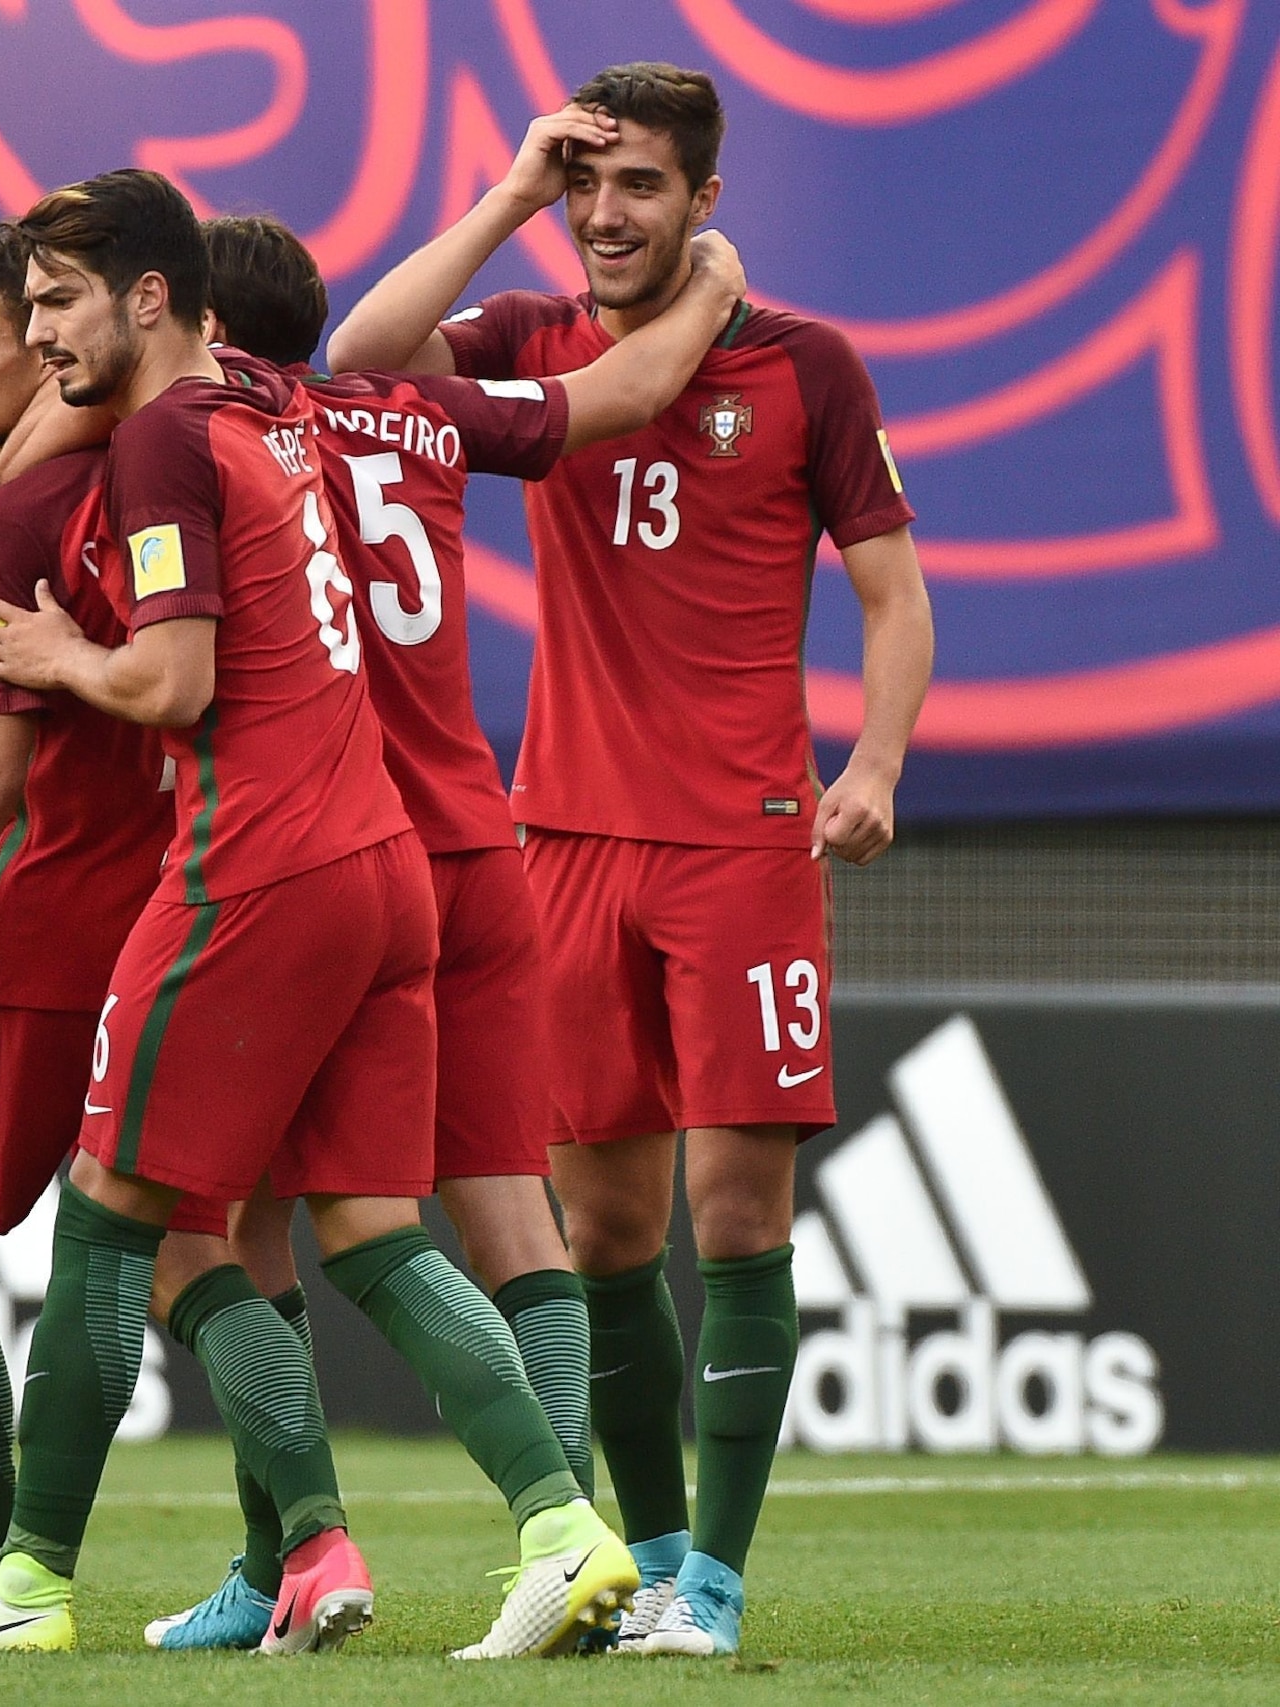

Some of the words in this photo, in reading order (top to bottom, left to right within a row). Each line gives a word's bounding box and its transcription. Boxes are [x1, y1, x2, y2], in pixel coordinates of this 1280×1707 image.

[341, 451, 442, 646] 5
[612, 457, 680, 550] 13
[302, 489, 361, 675] 6
[92, 993, 119, 1082] 6
[747, 959, 821, 1052] 13
[775, 1300, 1164, 1455] didas
